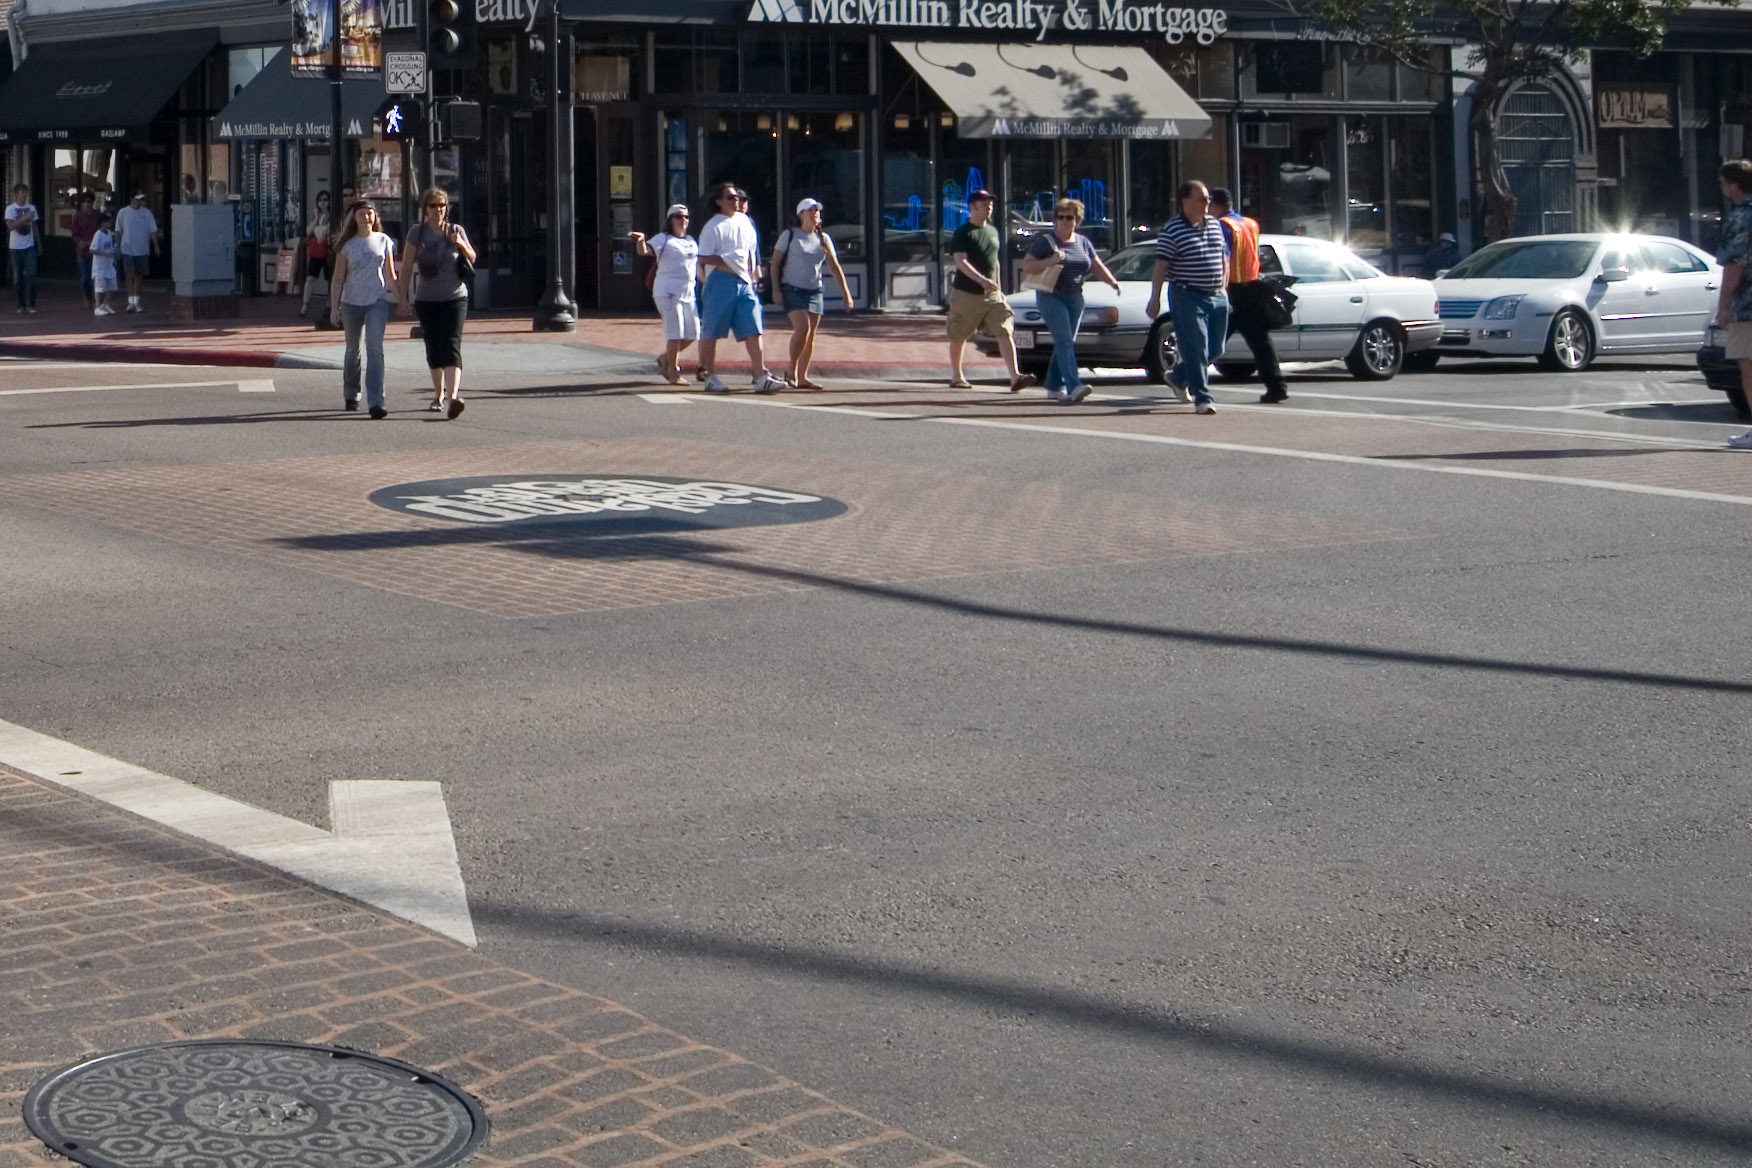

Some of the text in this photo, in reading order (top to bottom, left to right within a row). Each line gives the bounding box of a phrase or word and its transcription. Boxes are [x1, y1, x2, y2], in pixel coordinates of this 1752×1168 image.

[389, 55, 423, 63] DIAGONAL
[389, 71, 404, 85] OK
[234, 122, 331, 139] McMillin Realty & Mortg
[1013, 121, 1159, 139] McMillin Realty & Mortgage
